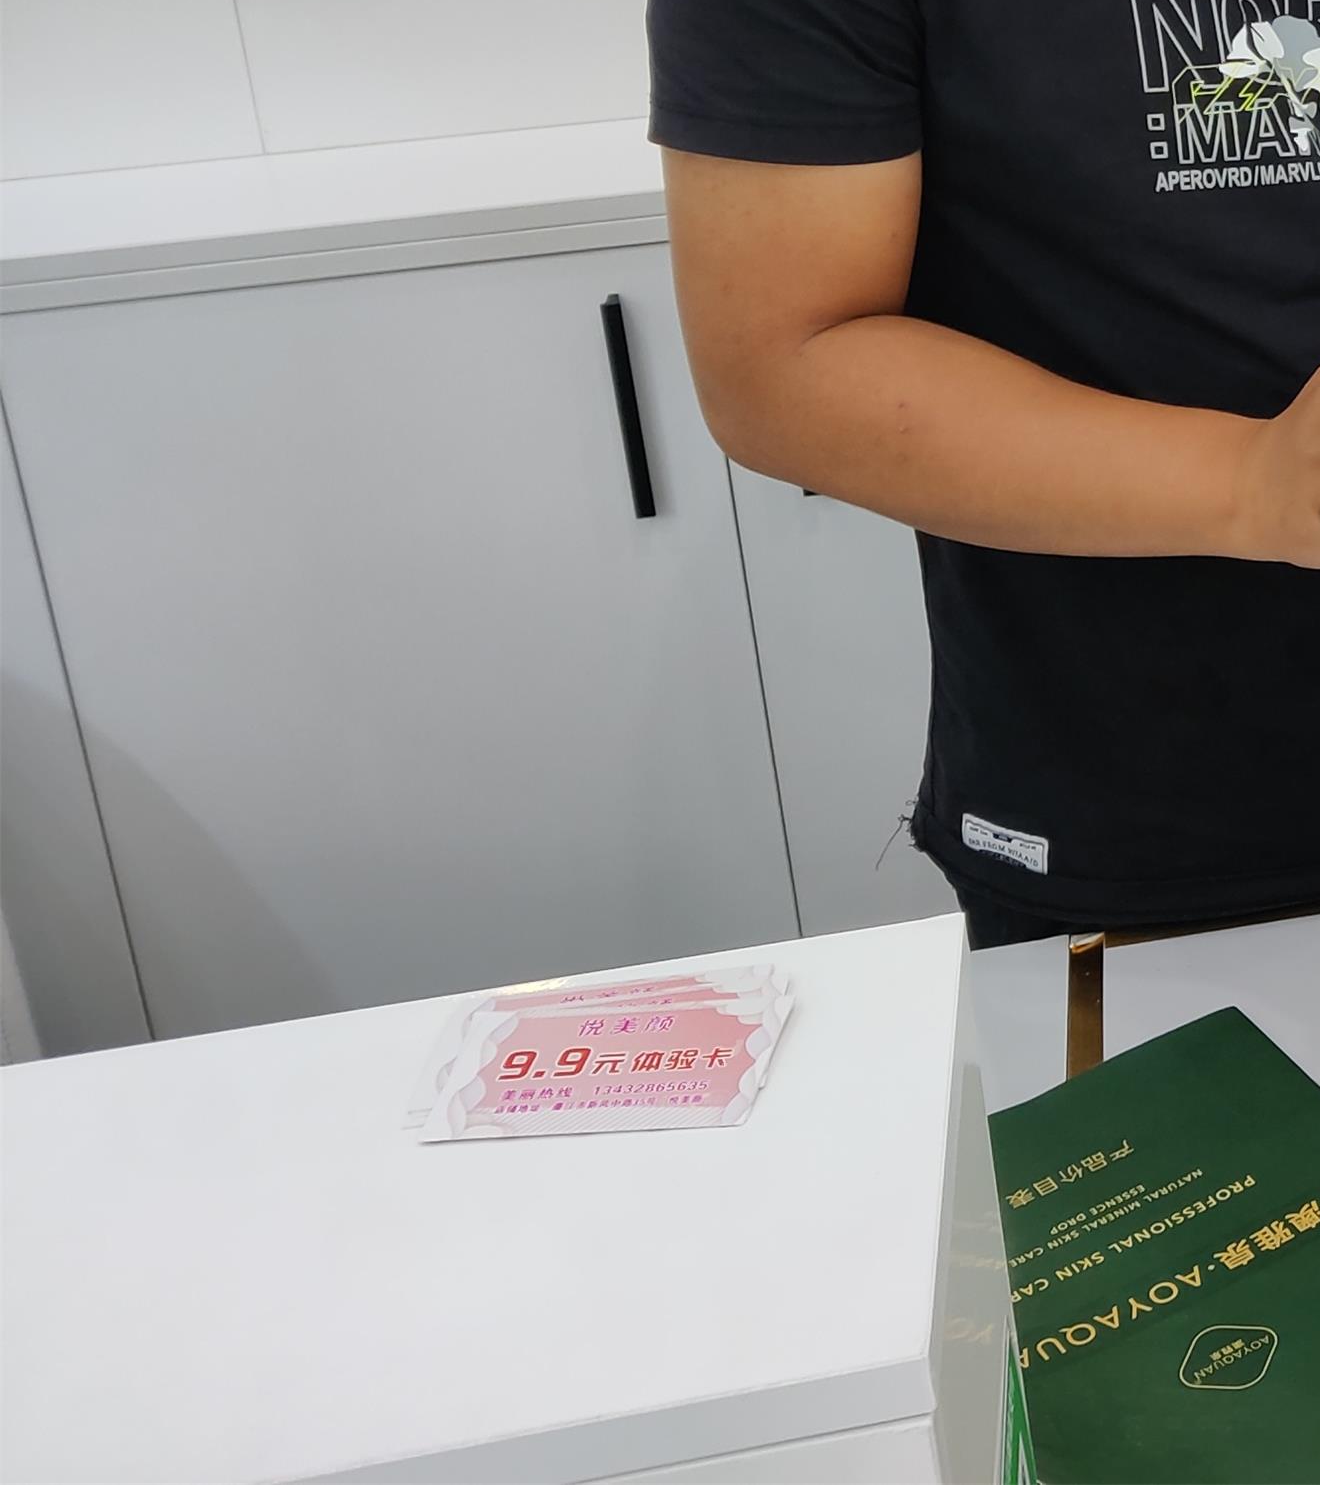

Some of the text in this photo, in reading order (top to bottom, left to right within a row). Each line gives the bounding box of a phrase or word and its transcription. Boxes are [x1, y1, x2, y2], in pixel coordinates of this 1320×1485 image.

[579, 1015, 674, 1036] 悦美颜
[498, 1047, 733, 1081] 9.9元体验卡
[1006, 1139, 1135, 1209] 产品价目表
[1141, 1168, 1204, 1205] NATURAL
[1048, 1183, 1146, 1236] ESSENCE DROP
[1081, 1199, 1141, 1234] MINERAL
[1107, 1173, 1257, 1256] PROFESSIONAL
[1046, 1228, 1080, 1250] SKIN
[1054, 1249, 1105, 1281] SKIN
